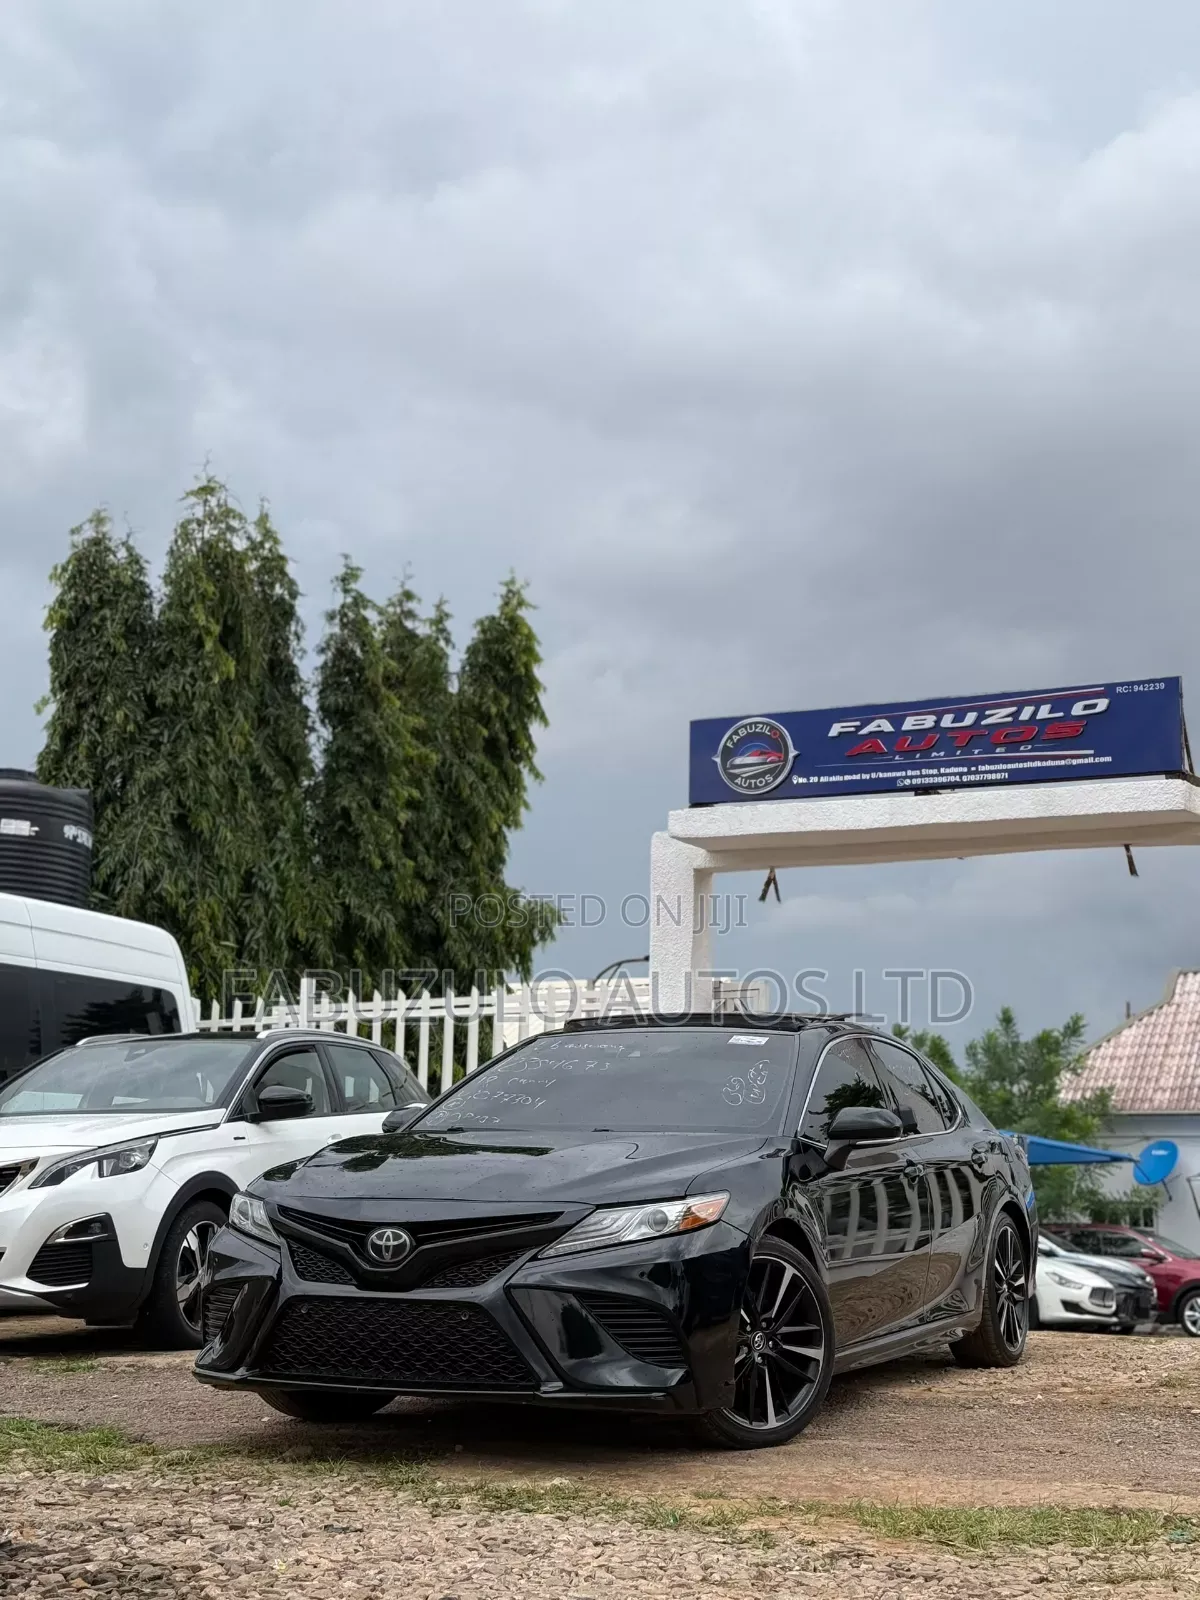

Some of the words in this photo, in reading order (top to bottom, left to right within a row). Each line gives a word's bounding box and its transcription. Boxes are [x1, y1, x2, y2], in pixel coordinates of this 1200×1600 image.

[828, 698, 1110, 737] FABUZILO
[726, 723, 780, 748] FABUZILO
[845, 720, 1087, 757] AUTOS
[894, 745, 1032, 760] LIMITED
[734, 774, 773, 788] AUTOS
[861, 772, 870, 780] by
[907, 768, 920, 776] Bus
[940, 765, 968, 774] Kaduna
